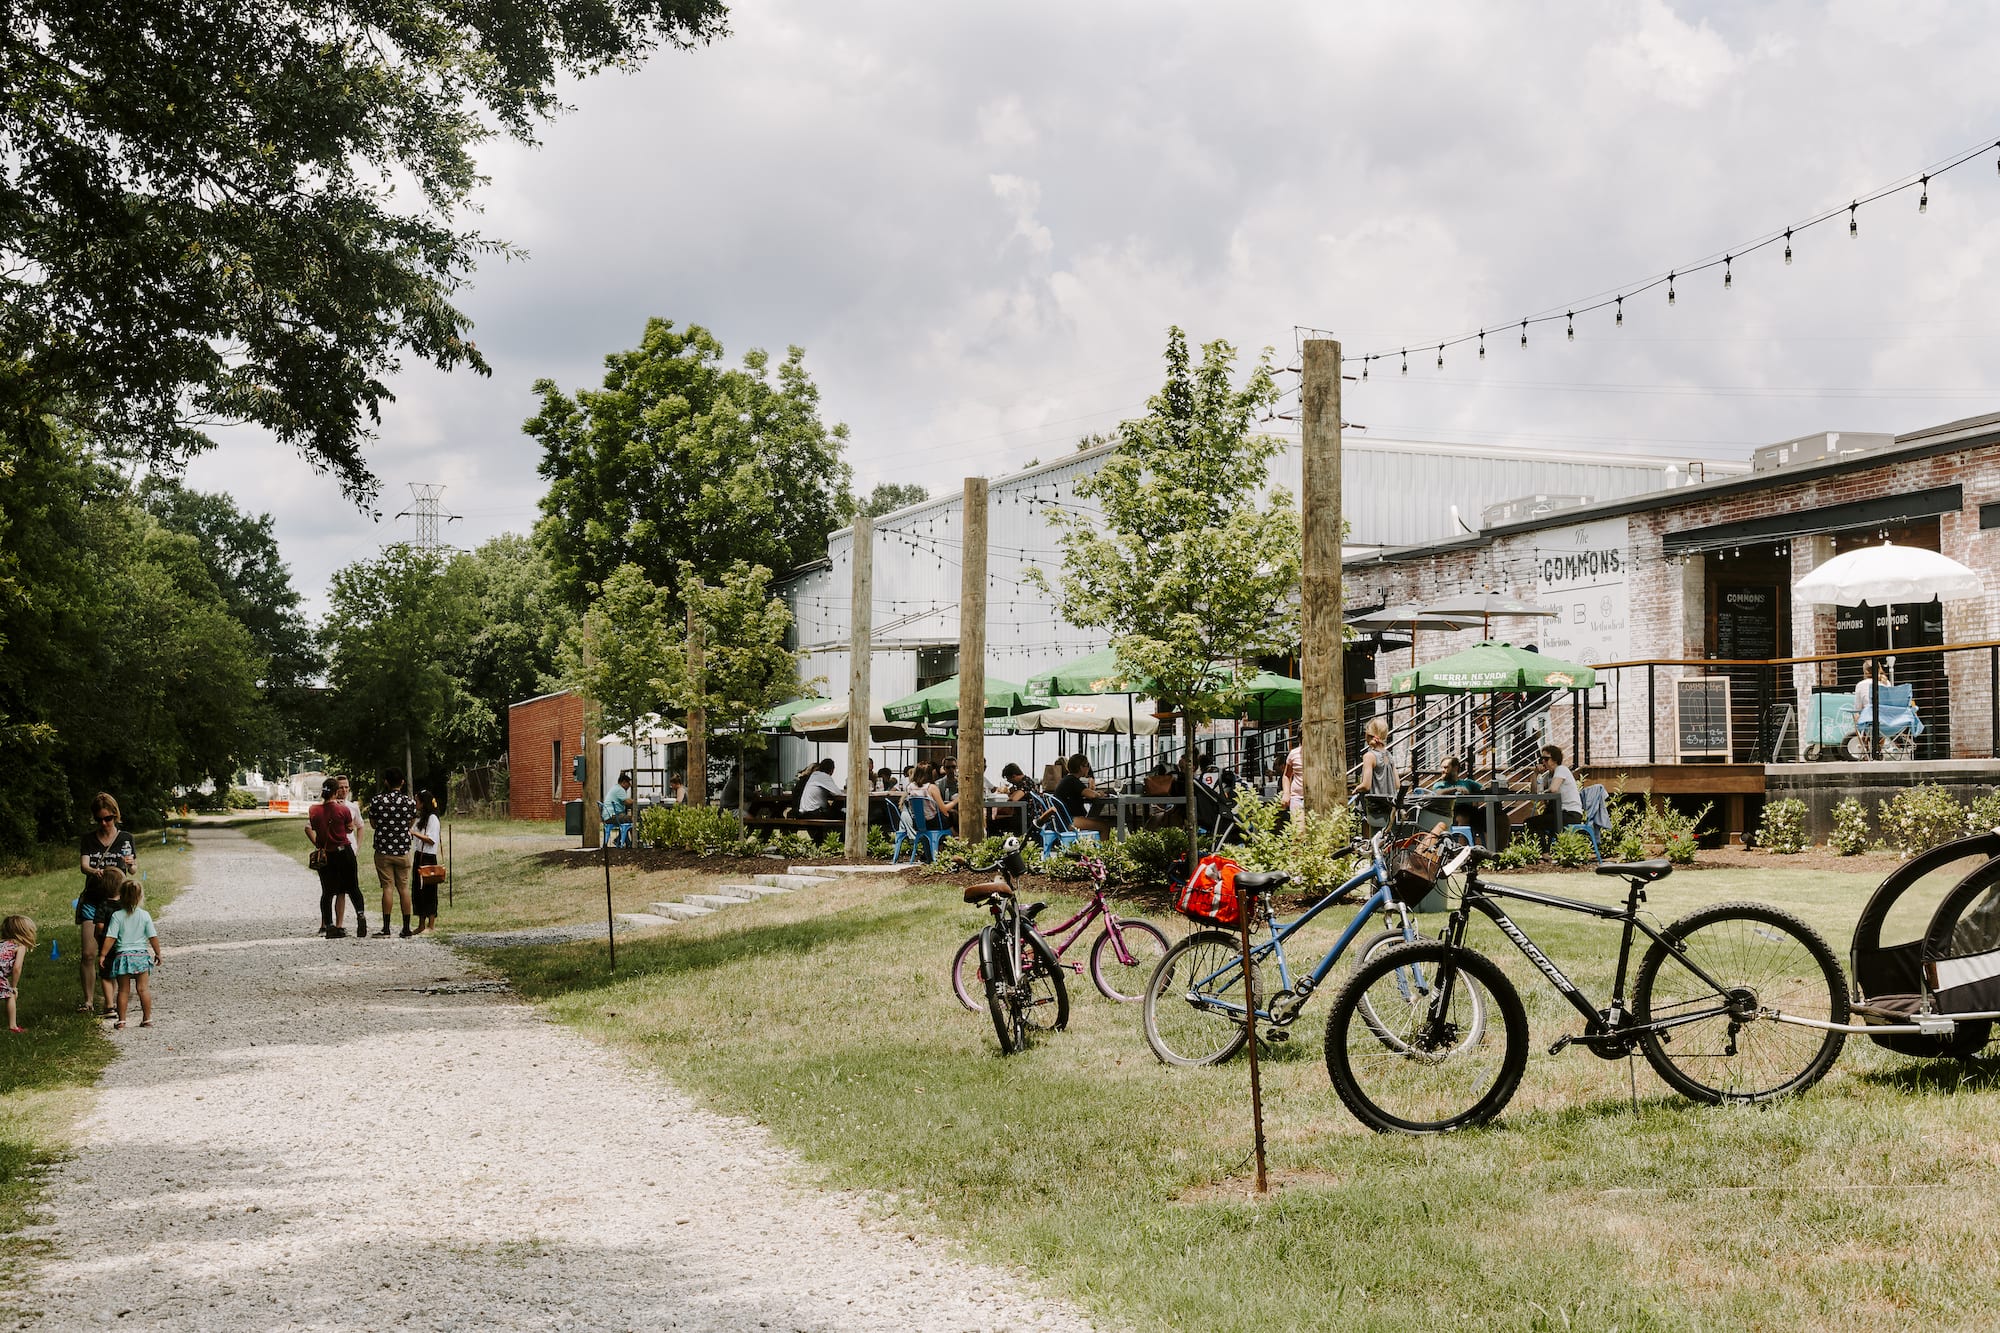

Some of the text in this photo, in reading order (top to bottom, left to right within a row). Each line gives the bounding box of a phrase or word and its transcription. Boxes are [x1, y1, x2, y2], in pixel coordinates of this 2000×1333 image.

[1575, 528, 1589, 545] The
[1544, 548, 1619, 582] COMMONS
[1727, 594, 1766, 603] COMMONS
[1836, 620, 1864, 630] OMMONS
[1433, 672, 1507, 681] SIERRA NEVADA
[1495, 915, 1576, 993] MONGOOSE
